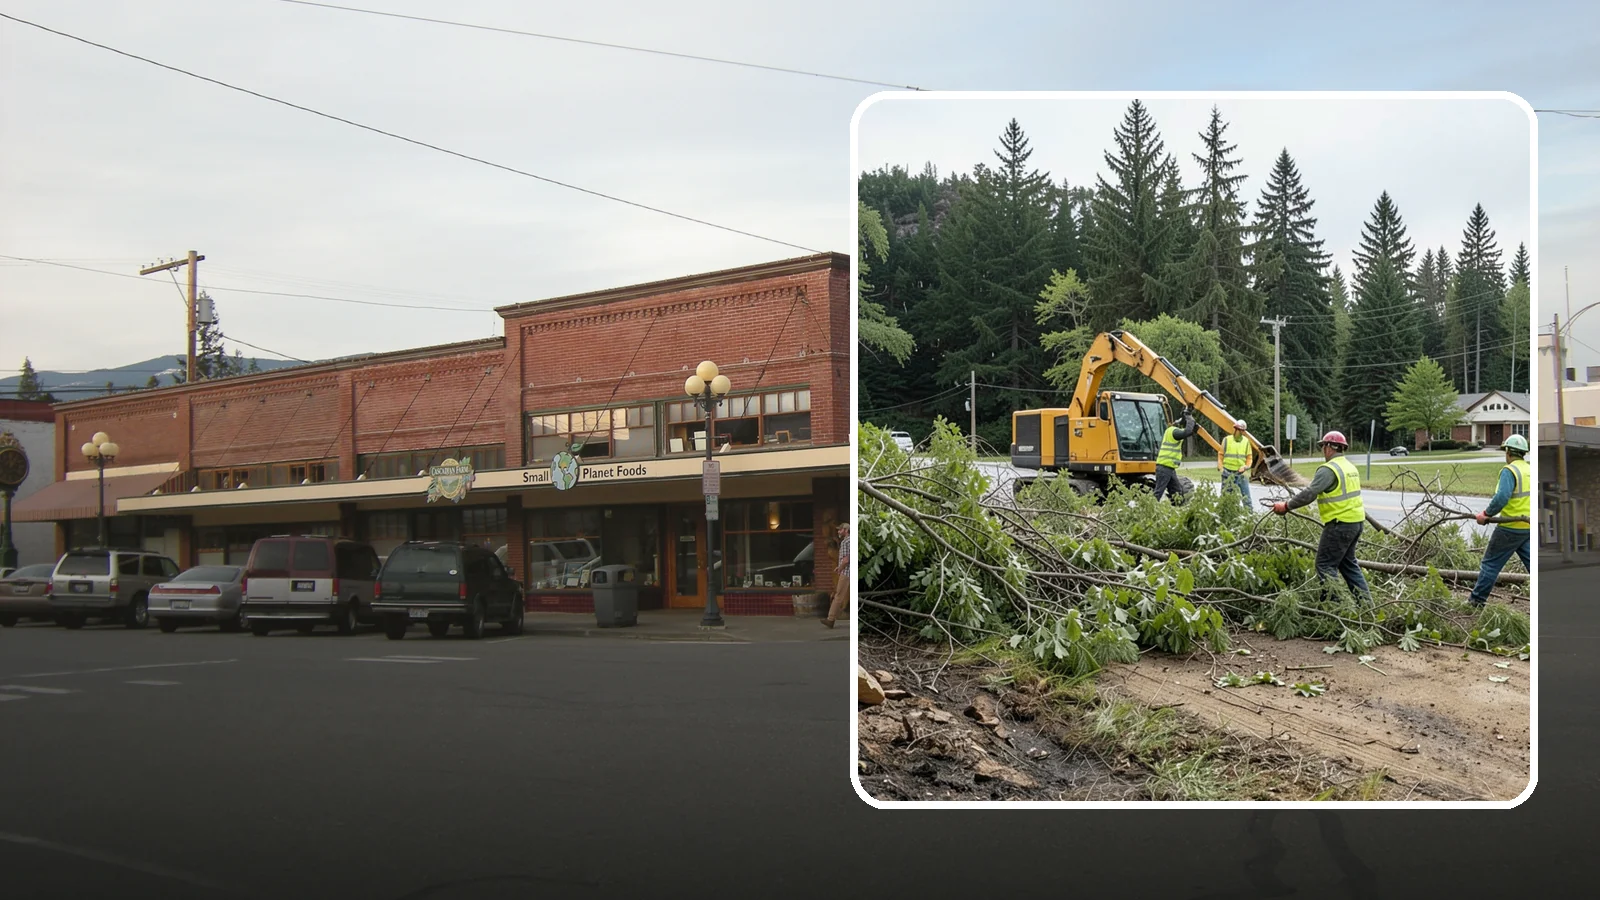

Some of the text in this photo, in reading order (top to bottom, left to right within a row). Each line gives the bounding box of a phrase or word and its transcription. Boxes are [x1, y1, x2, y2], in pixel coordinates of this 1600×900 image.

[523, 464, 647, 483] Small Planet Foods
